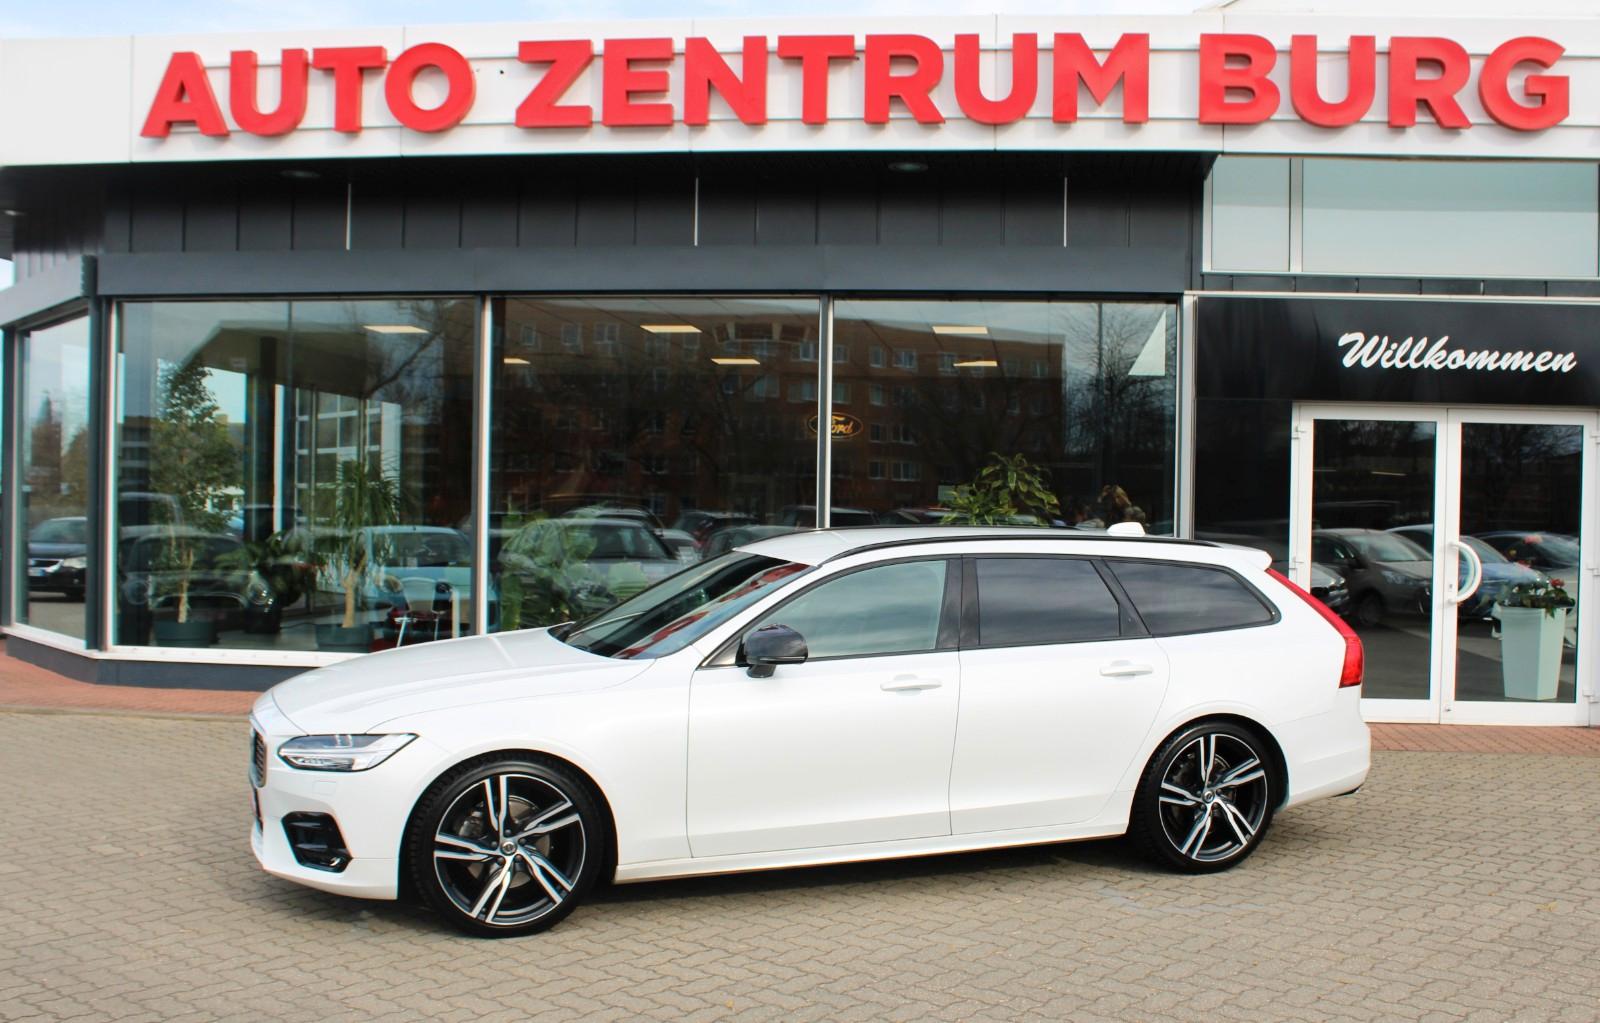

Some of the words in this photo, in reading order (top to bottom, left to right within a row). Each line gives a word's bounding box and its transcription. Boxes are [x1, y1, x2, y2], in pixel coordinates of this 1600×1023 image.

[140, 41, 477, 138] AUTO
[513, 33, 1151, 130] ZENTRUM
[1197, 34, 1570, 132] BURG
[1337, 331, 1577, 373] Willkommen
